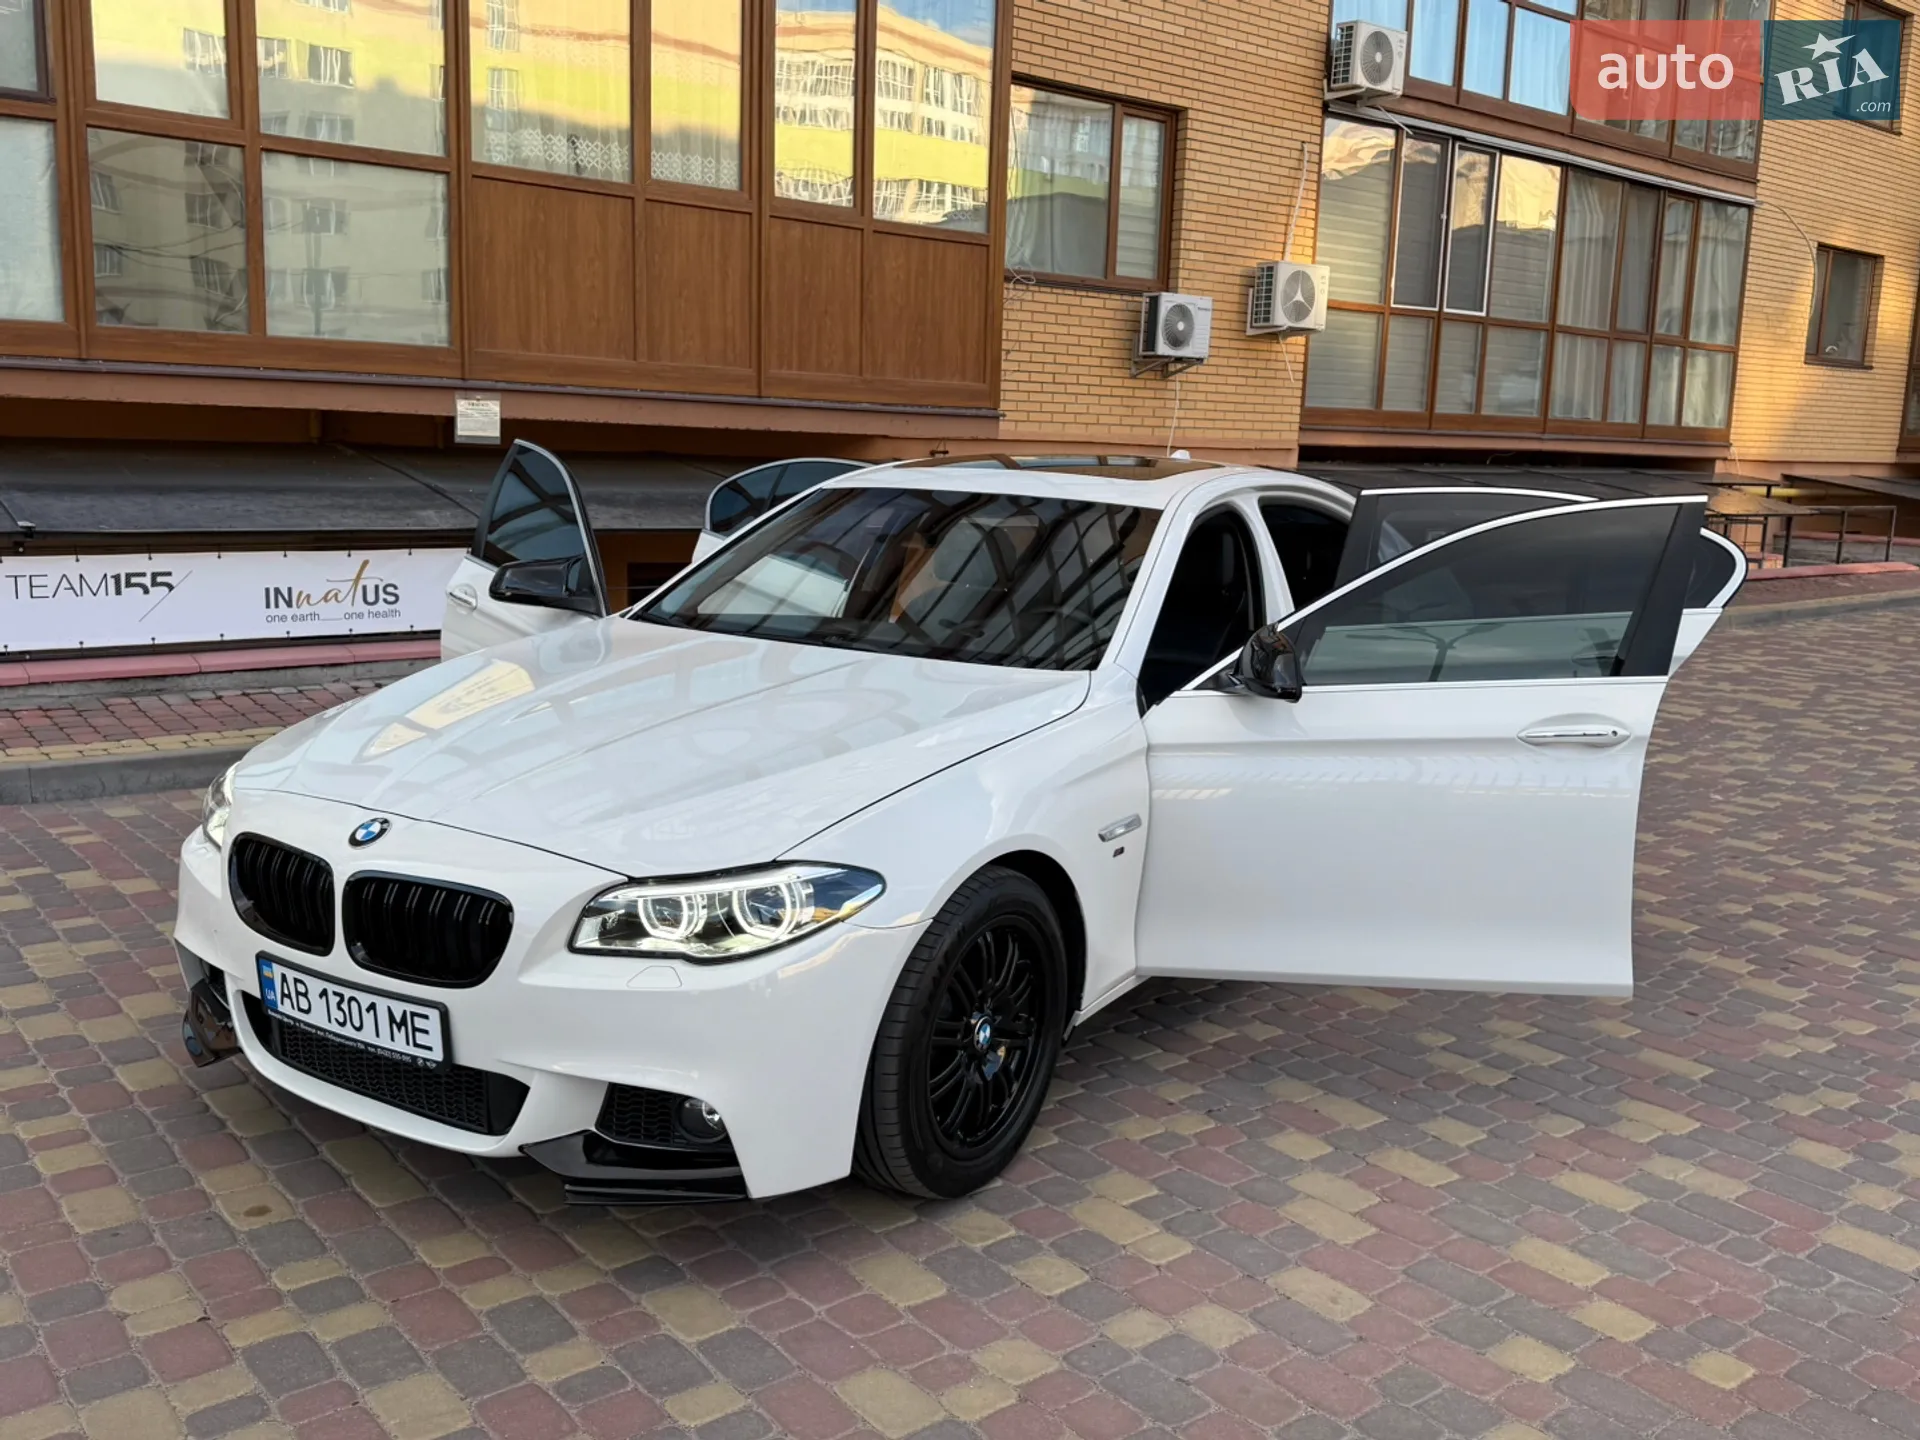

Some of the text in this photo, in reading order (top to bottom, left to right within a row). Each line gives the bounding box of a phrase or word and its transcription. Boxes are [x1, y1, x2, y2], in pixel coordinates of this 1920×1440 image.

[265, 614, 288, 623] one
[367, 608, 401, 619] health
[265, 987, 276, 1001] UA
[280, 971, 312, 1015] AB
[318, 988, 380, 1038] 1301
[387, 1005, 434, 1052] ME
